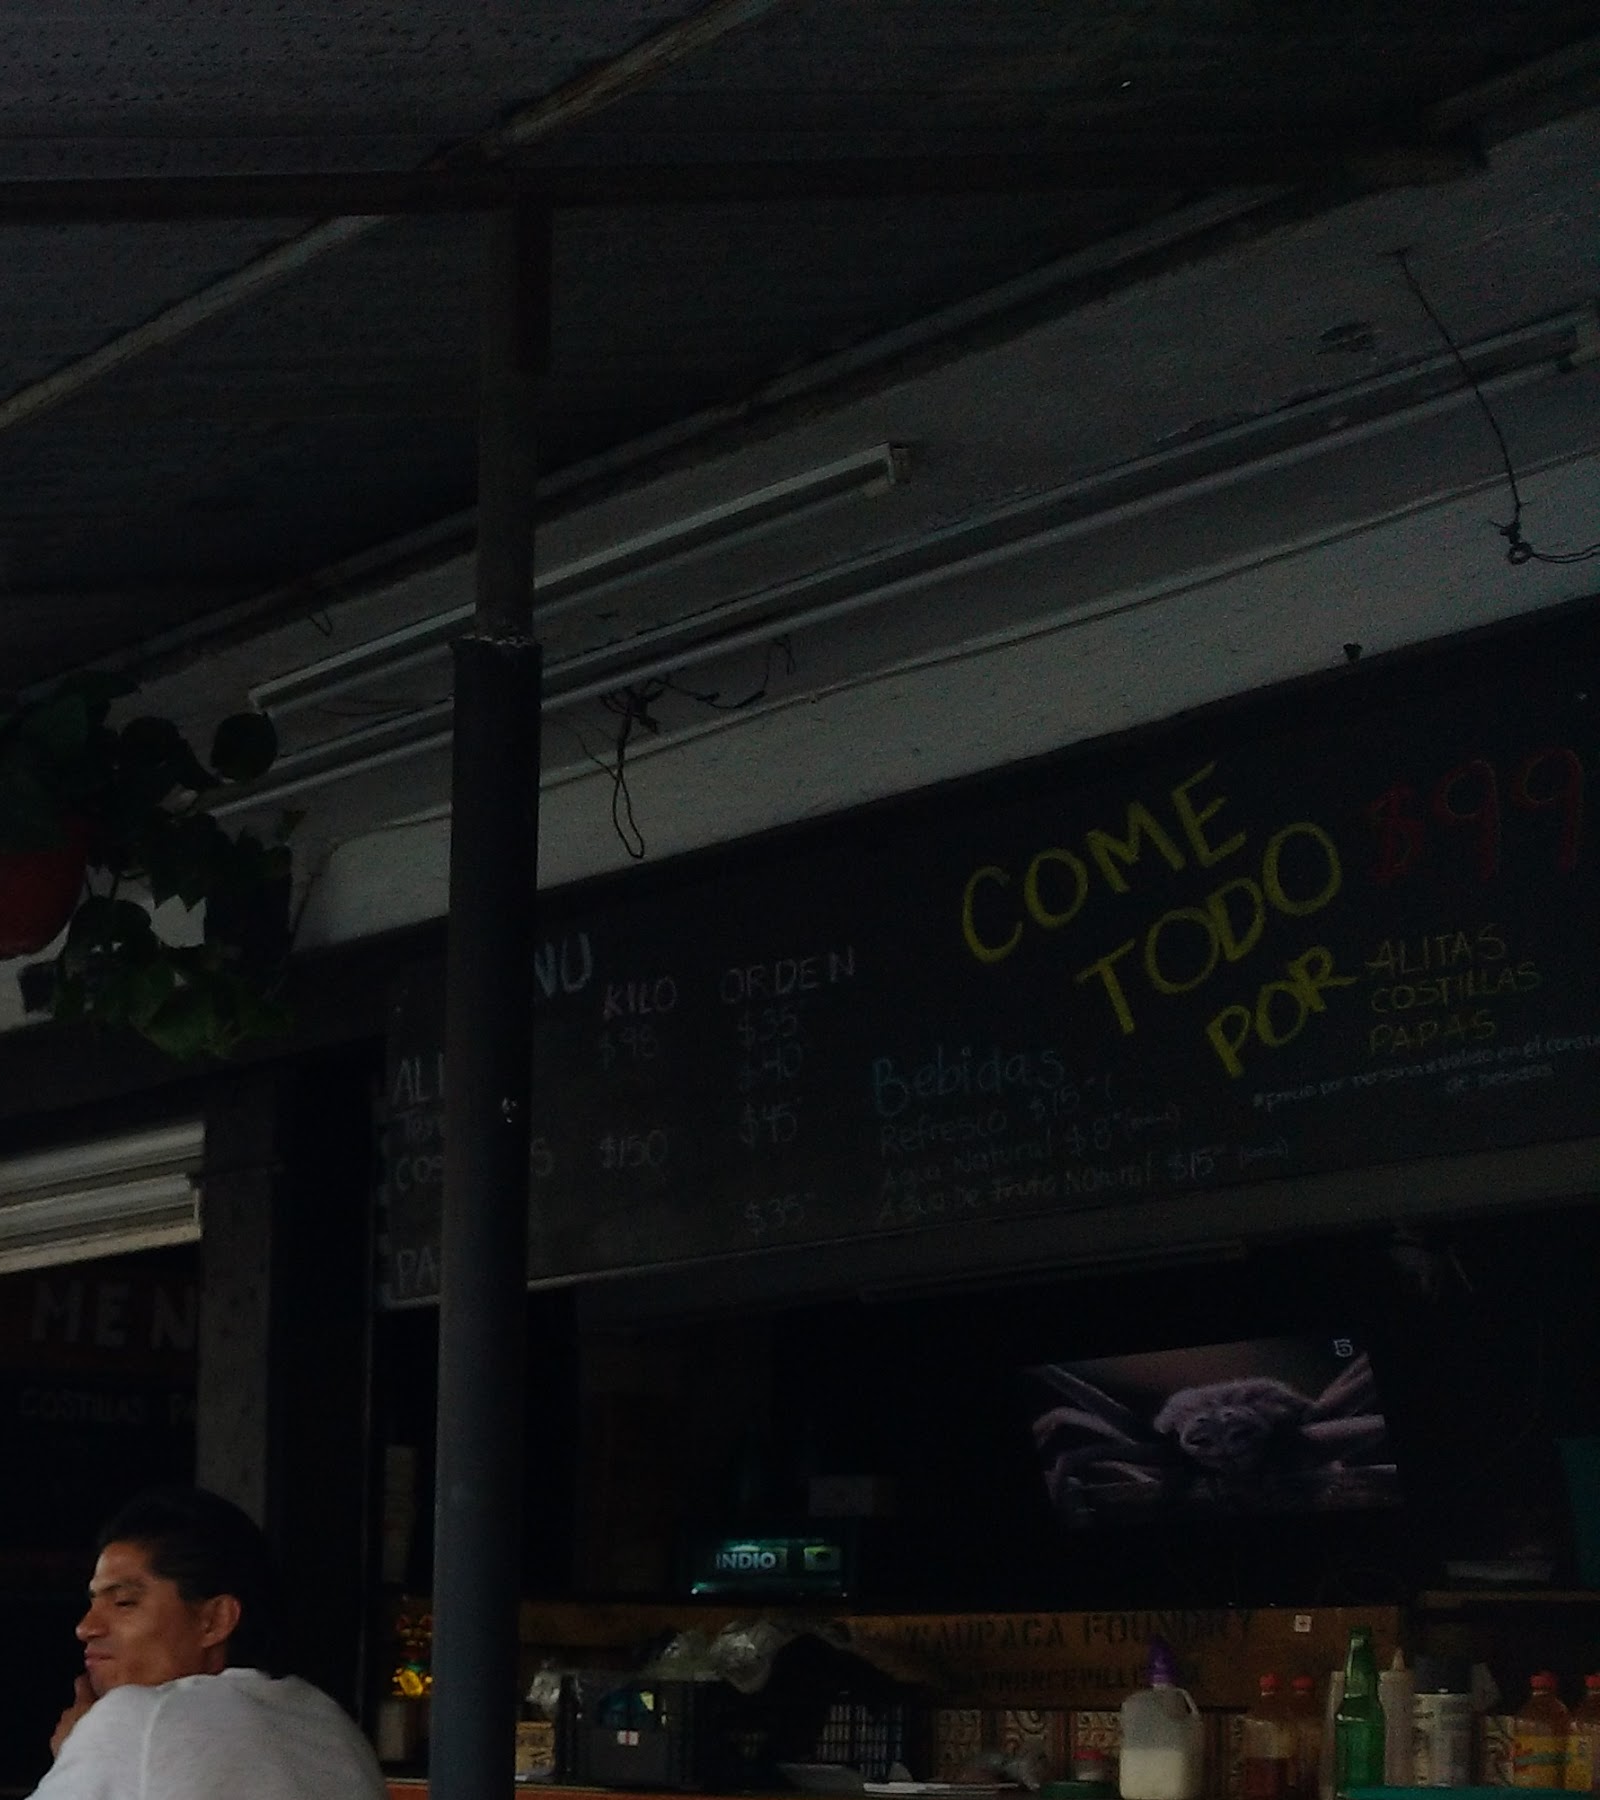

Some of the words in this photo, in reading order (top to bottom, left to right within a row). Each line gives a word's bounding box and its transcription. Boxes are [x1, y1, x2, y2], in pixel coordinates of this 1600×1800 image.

[1363, 747, 1586, 887] $99
[962, 760, 1247, 963] COME
[1074, 821, 1343, 1035] TODO
[1364, 922, 1507, 978] ALITAS
[533, 932, 594, 998] NU
[602, 976, 678, 1021] KILO
[720, 946, 856, 1005] ORDEN
[1371, 961, 1543, 1014] COSTILLAS
[1204, 945, 1358, 1079] POR
[1368, 1008, 1498, 1056] PAPAS
[872, 1043, 1065, 1118] Bebidas
[30, 1279, 194, 1351] MEN
[715, 1550, 777, 1571] INDIO
